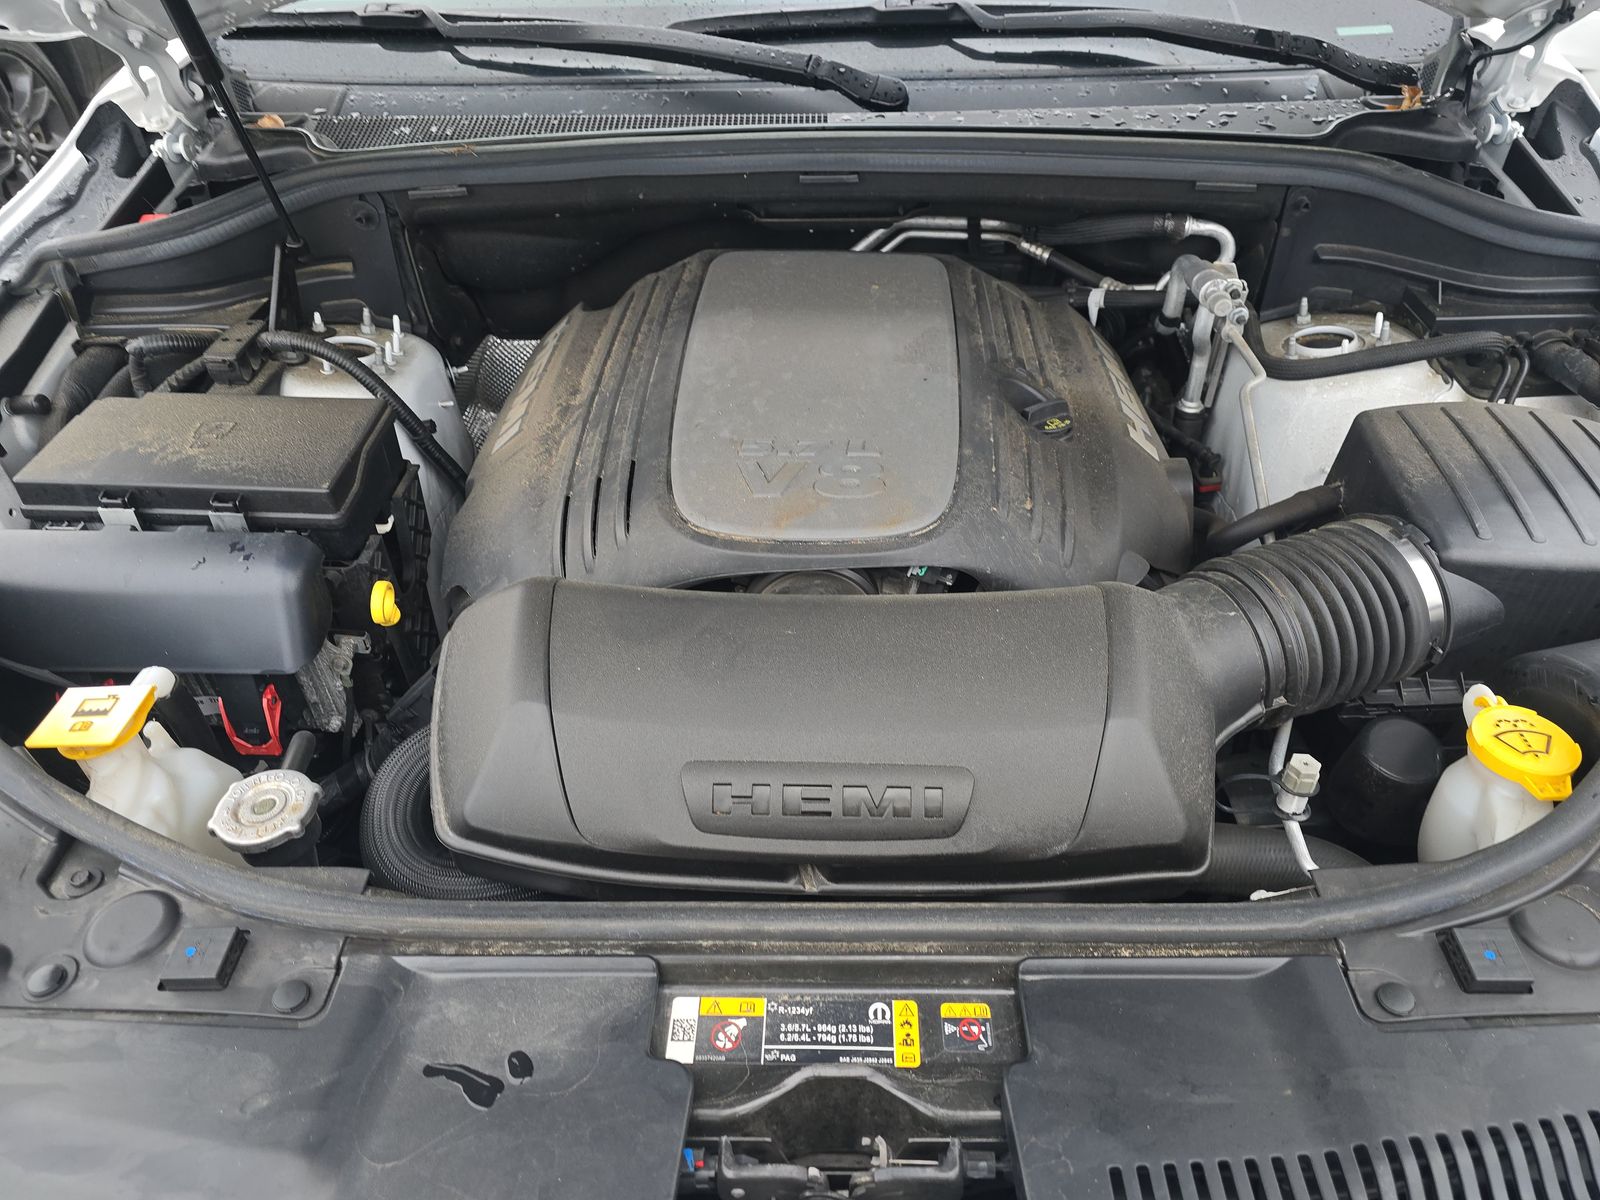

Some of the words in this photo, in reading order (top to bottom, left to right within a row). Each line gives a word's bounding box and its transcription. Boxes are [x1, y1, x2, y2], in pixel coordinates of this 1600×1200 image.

[736, 460, 887, 499] V8
[712, 782, 944, 819] HEMI
[778, 1005, 814, 1017] R-1234yf
[780, 1053, 797, 1062] PAG
